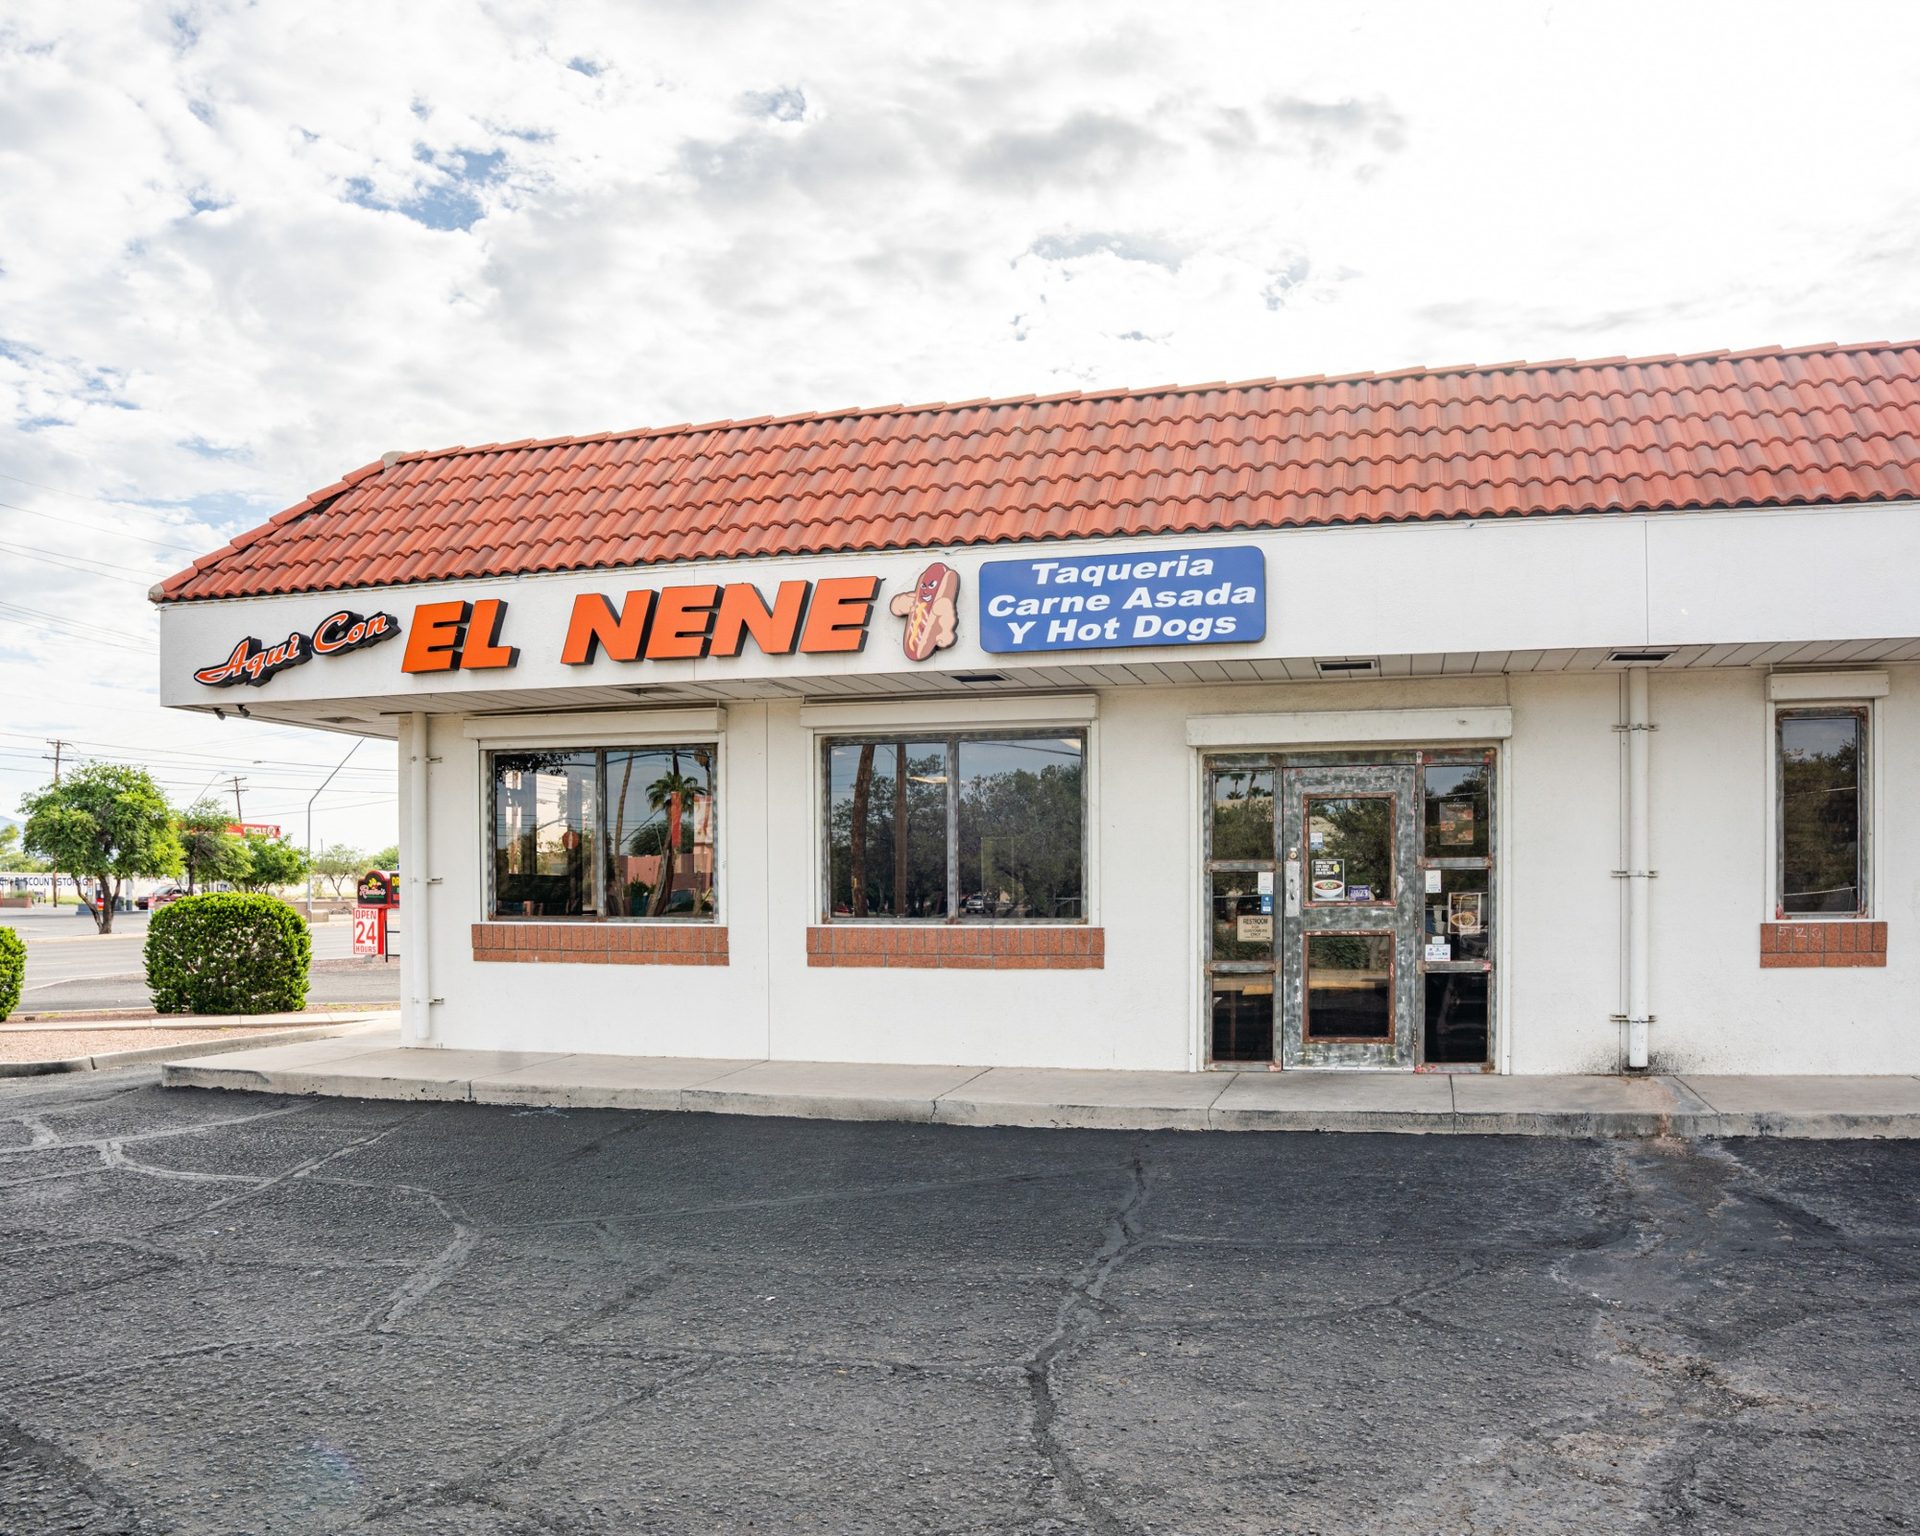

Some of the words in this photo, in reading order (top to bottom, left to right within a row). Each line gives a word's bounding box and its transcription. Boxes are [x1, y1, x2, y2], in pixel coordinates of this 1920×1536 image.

[1031, 554, 1214, 588] Taqueria
[987, 594, 1111, 618] Carne
[1121, 582, 1257, 610] Asada
[401, 600, 519, 673] EL
[560, 577, 882, 665] NENE
[1007, 621, 1037, 645] Y
[1046, 617, 1120, 643] Hot
[1132, 615, 1238, 641] Dogs
[194, 631, 308, 686] Aqui
[312, 610, 399, 656] Con
[355, 909, 377, 920] OPEN
[355, 921, 377, 945] 24
